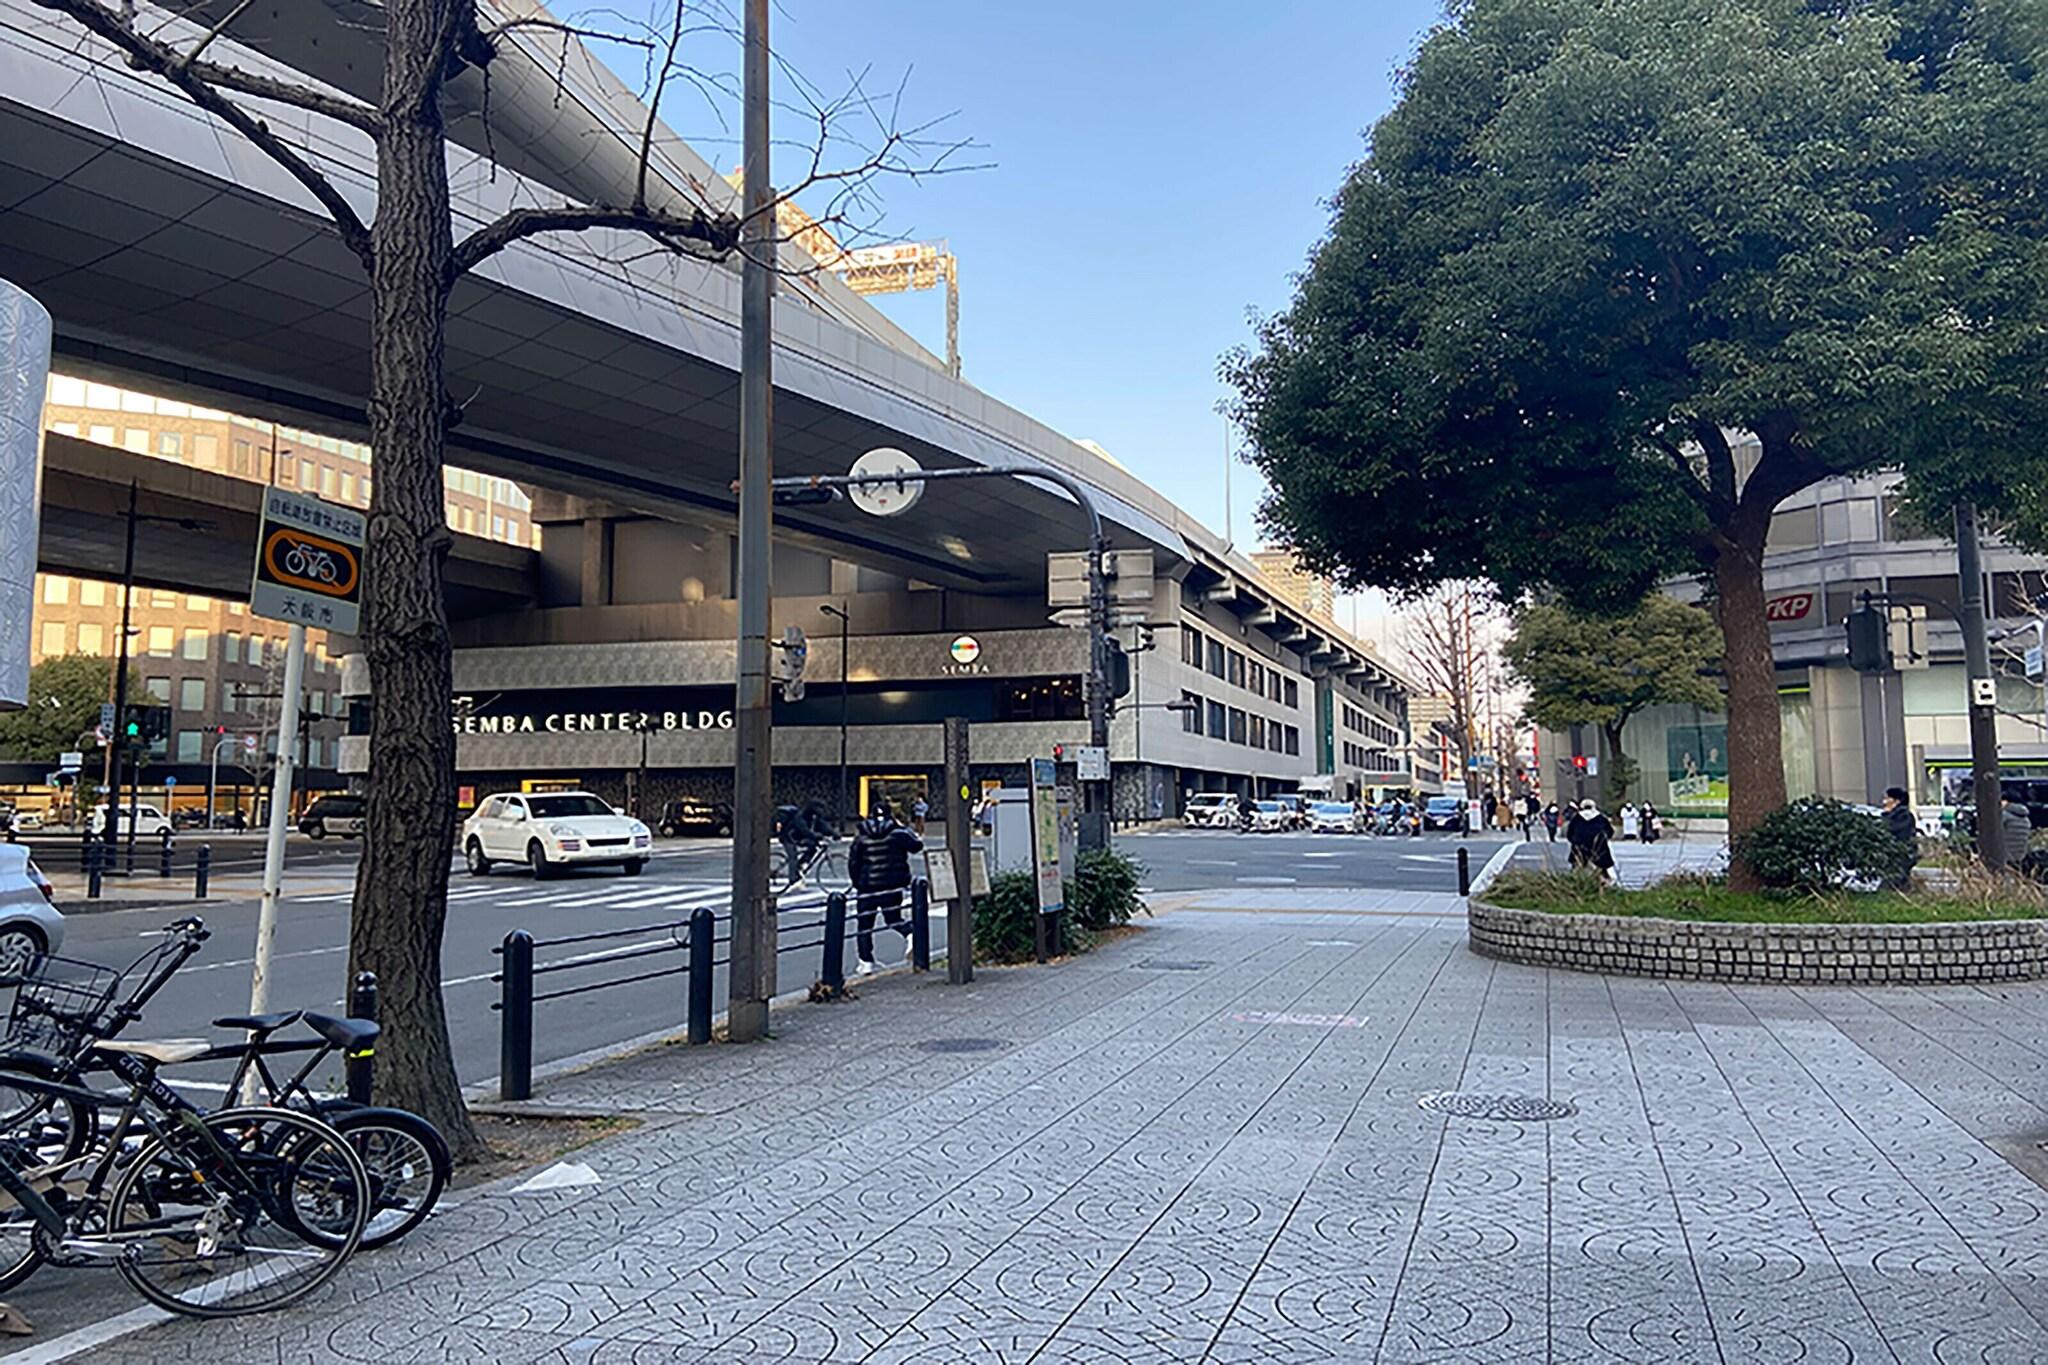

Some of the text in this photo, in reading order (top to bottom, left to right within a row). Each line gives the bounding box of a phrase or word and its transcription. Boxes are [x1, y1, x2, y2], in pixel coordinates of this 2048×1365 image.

[282, 597, 333, 624] 大阪市
[1766, 598, 1808, 617] TKP
[452, 710, 733, 733] SEMBA CENTER BLDG
